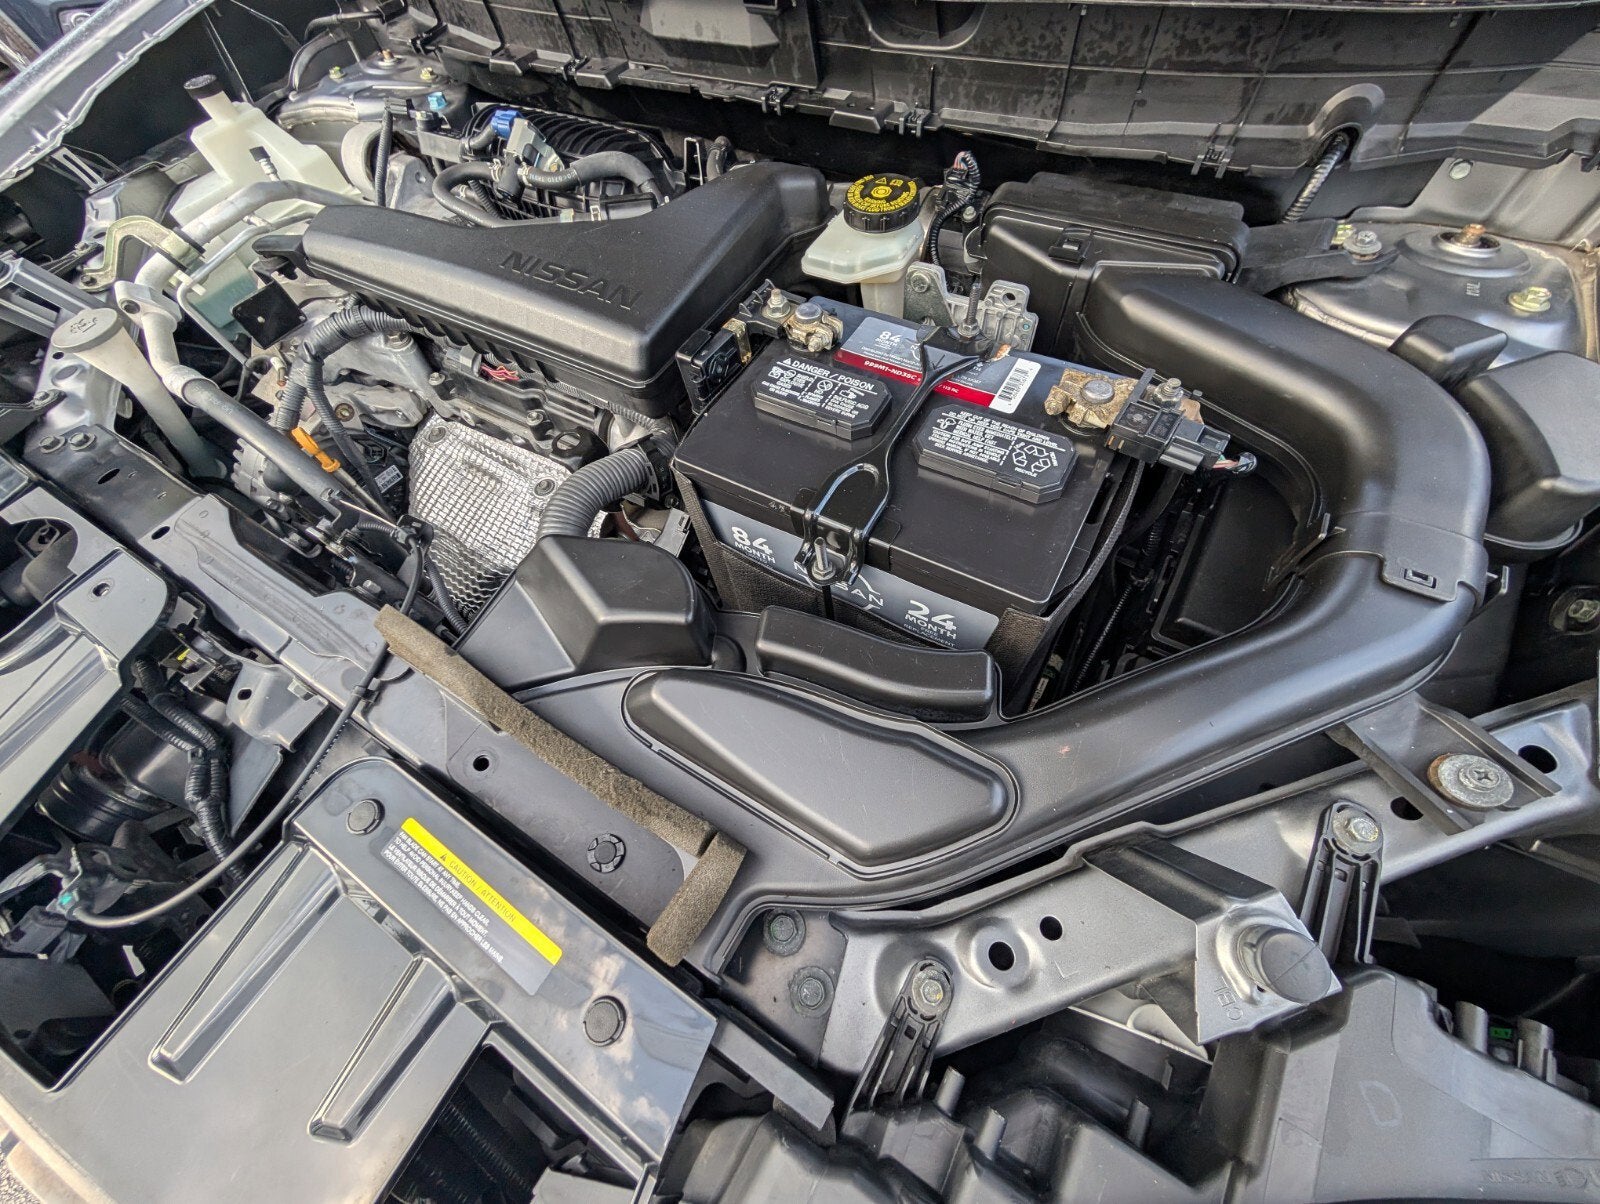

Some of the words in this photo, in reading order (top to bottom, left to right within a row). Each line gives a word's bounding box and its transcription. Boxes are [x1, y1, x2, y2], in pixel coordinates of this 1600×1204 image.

[498, 250, 643, 310] NISSAN
[879, 331, 903, 343] 84
[792, 361, 830, 376] DANGER
[838, 375, 874, 390] POISON
[732, 527, 773, 554] 84
[735, 542, 775, 564] MONTH
[905, 614, 956, 639] MONTH
[908, 600, 957, 631] 24
[448, 860, 478, 887] CAUTION
[480, 889, 517, 922] ATTENTION
